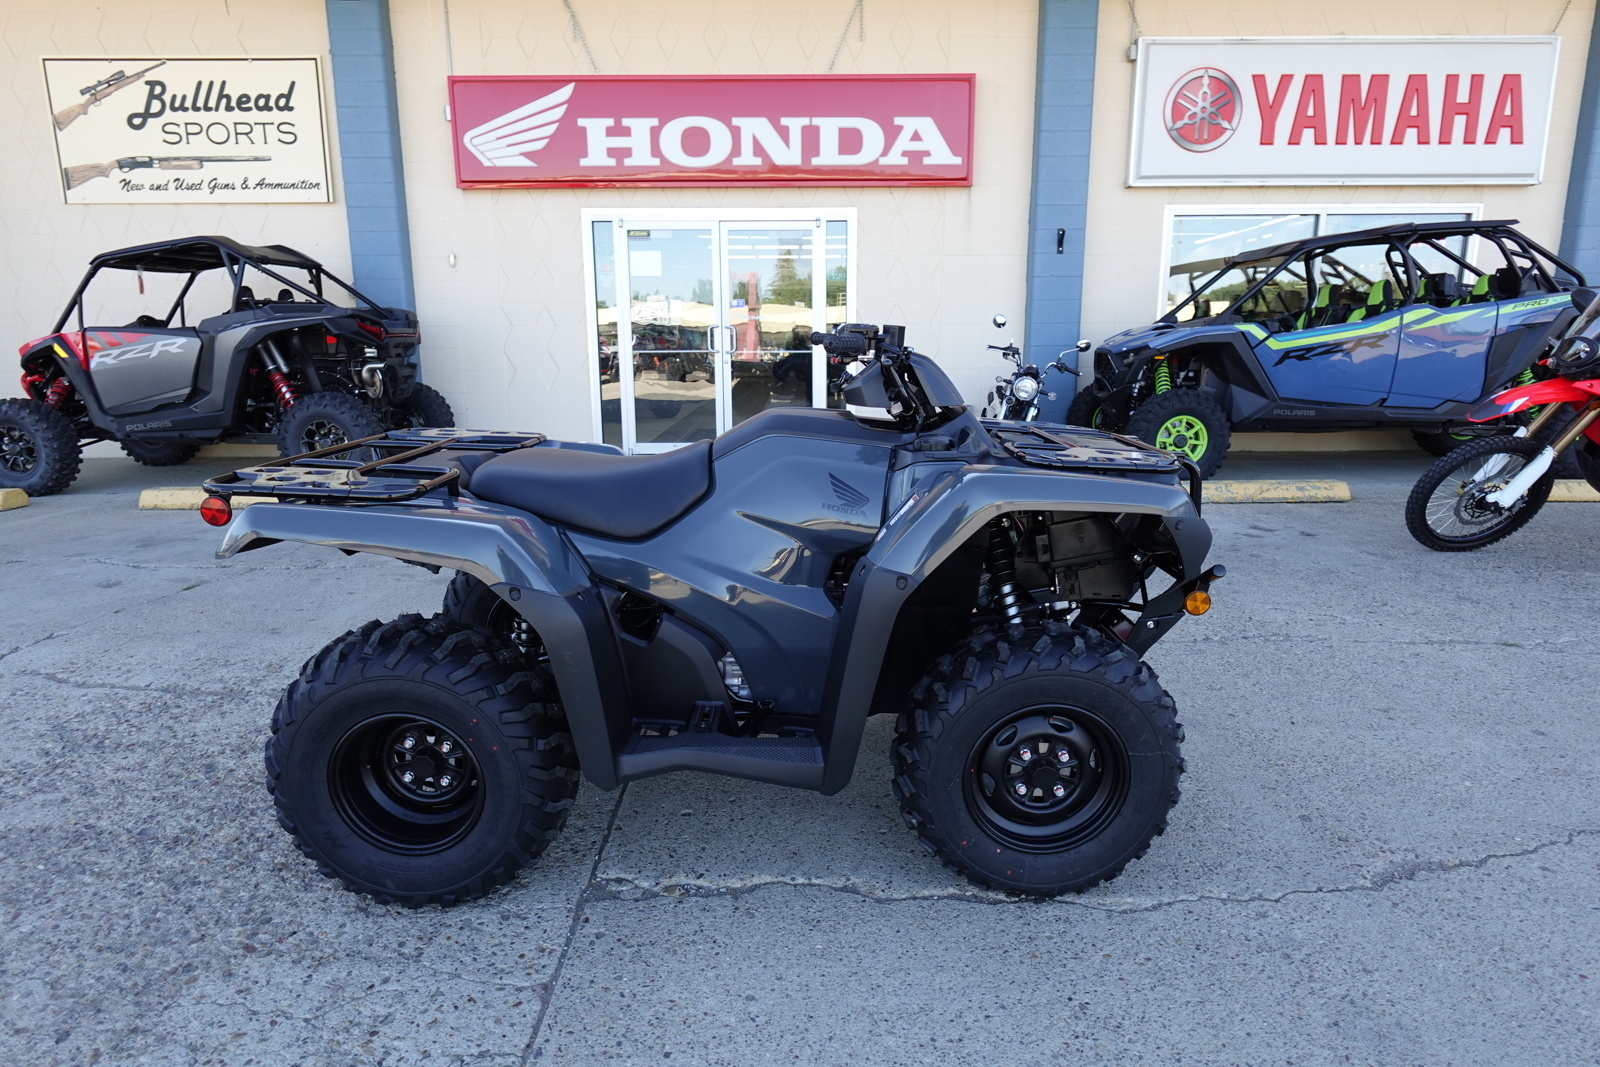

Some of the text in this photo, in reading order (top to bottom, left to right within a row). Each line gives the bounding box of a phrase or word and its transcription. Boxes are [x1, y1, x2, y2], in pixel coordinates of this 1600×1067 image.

[126, 79, 296, 131] Bullhead
[1251, 73, 1524, 146] YAMAHA
[161, 121, 298, 145] SPORTS
[577, 115, 963, 168] HONDA
[119, 176, 321, 194] New and Used Guns & Ammunition
[1512, 299, 1550, 310] PRO
[90, 338, 187, 369] RZR
[1272, 333, 1390, 368] RZR
[1273, 409, 1316, 417] POLARIS
[125, 420, 172, 432] POLARIS
[821, 503, 867, 517] HONDA
